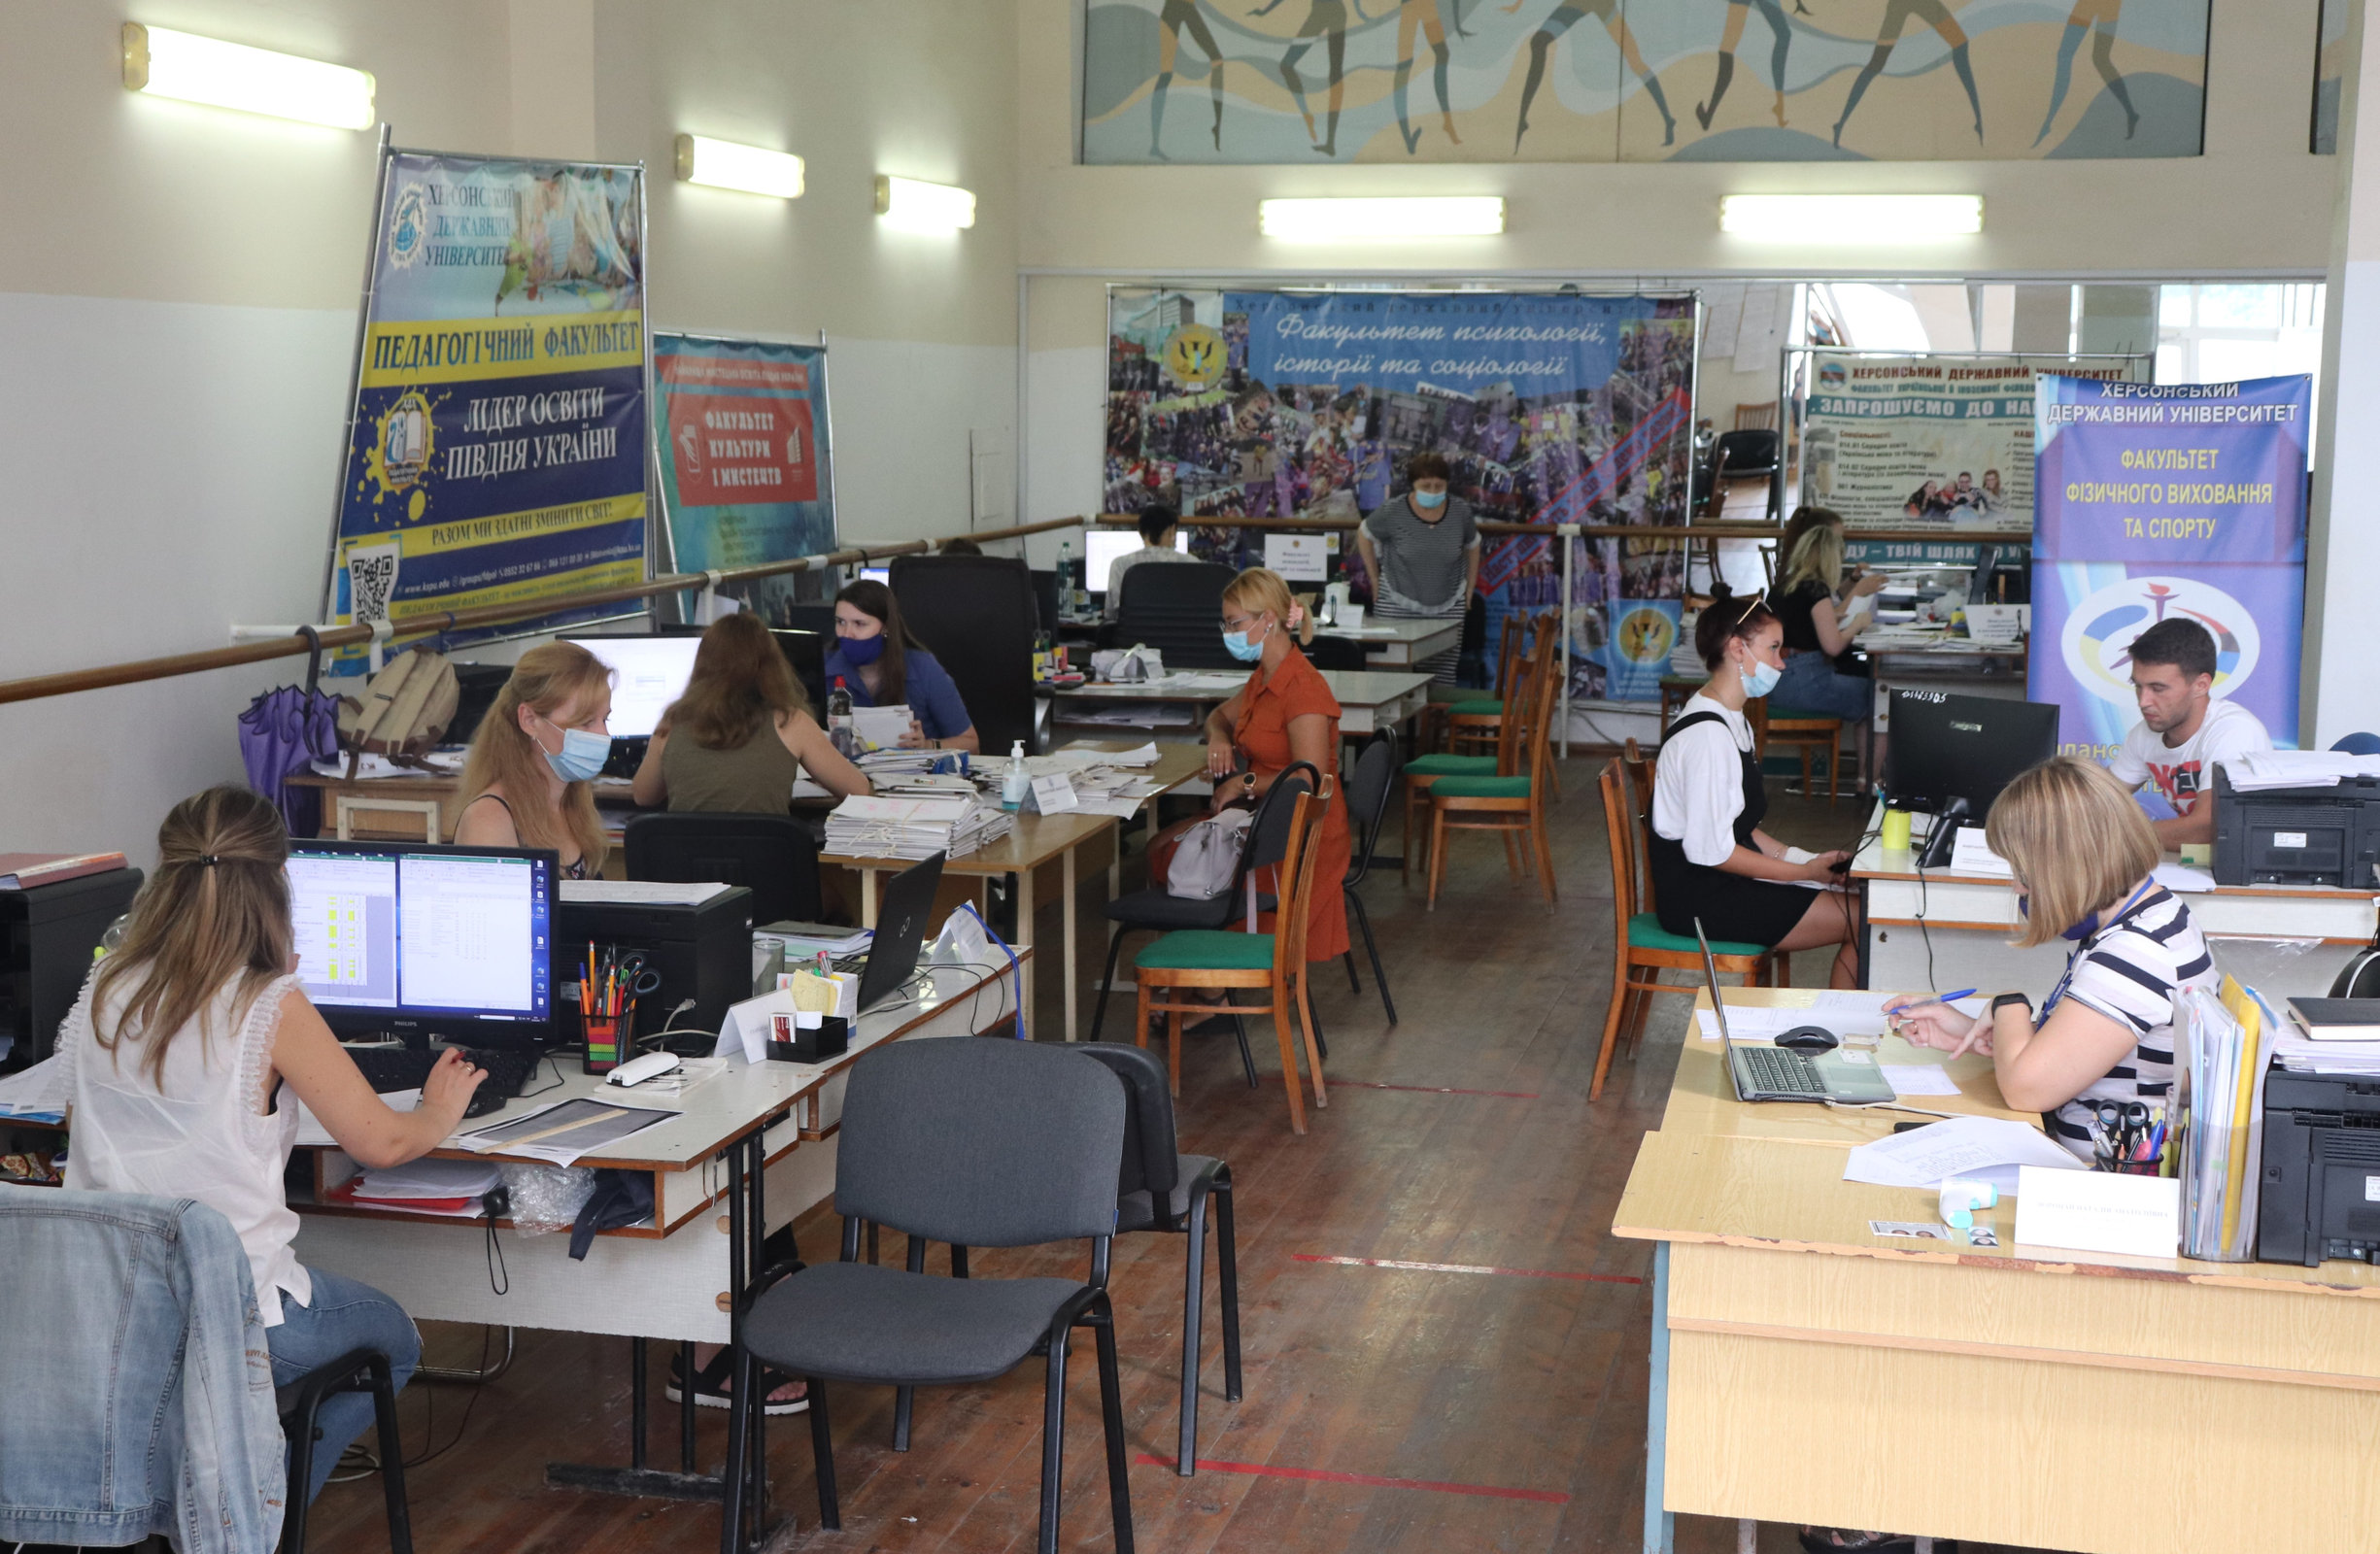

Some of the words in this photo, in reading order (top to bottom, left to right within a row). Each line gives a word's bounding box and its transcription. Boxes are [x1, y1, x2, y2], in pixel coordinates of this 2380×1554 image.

[1275, 313, 1445, 349] Факультет
[373, 322, 534, 376] ПЕДАГОГІЧНИЙ
[544, 321, 638, 358] ФАКУЛЬТЕТ
[1275, 354, 1376, 382] історії
[1379, 358, 1422, 374] та
[1430, 355, 1569, 380] соціології
[1853, 365, 1942, 379] ХЕРСОНСЬКИЙ
[1949, 365, 2029, 381] ДЕРЖАВНИЙ
[464, 394, 527, 436] ЛІДЕР
[530, 388, 604, 425] ОСВІТИ
[1820, 397, 1955, 417] ЗАПРОШУЄМО
[1965, 400, 1994, 418] ДО
[2048, 402, 2164, 424] ДЕРЖАВНИЙ
[2169, 404, 2298, 423] УНІВЕРСИТЕТ
[705, 411, 774, 430] ФАКУЛЬТЕТ
[446, 437, 527, 482] ПІВДНЯ
[533, 422, 617, 468] УКРАЇНИ
[708, 439, 771, 458] КУЛЬТУРИ
[2121, 449, 2219, 469] ФАКУЛЬТЕТ
[712, 468, 719, 487] І
[721, 467, 782, 486] МИСТЕЦТВ
[2066, 483, 2162, 504] ФІЗИЧНОГО
[2167, 484, 2272, 504] ВИХОВАННЯ
[432, 525, 472, 547] РАЗОМ
[474, 522, 493, 538] МИ
[494, 516, 532, 537] ЗДАТНІ
[534, 508, 583, 528] ЗМІНИТИ
[585, 502, 612, 521] СВІТ!
[2124, 519, 2143, 538] ТА
[2149, 519, 2216, 538] СПОРТУ
[1846, 544, 1867, 559] ДУ
[1886, 543, 1922, 558] ТВІЙ
[1927, 545, 1975, 559] ШЛЯХ
